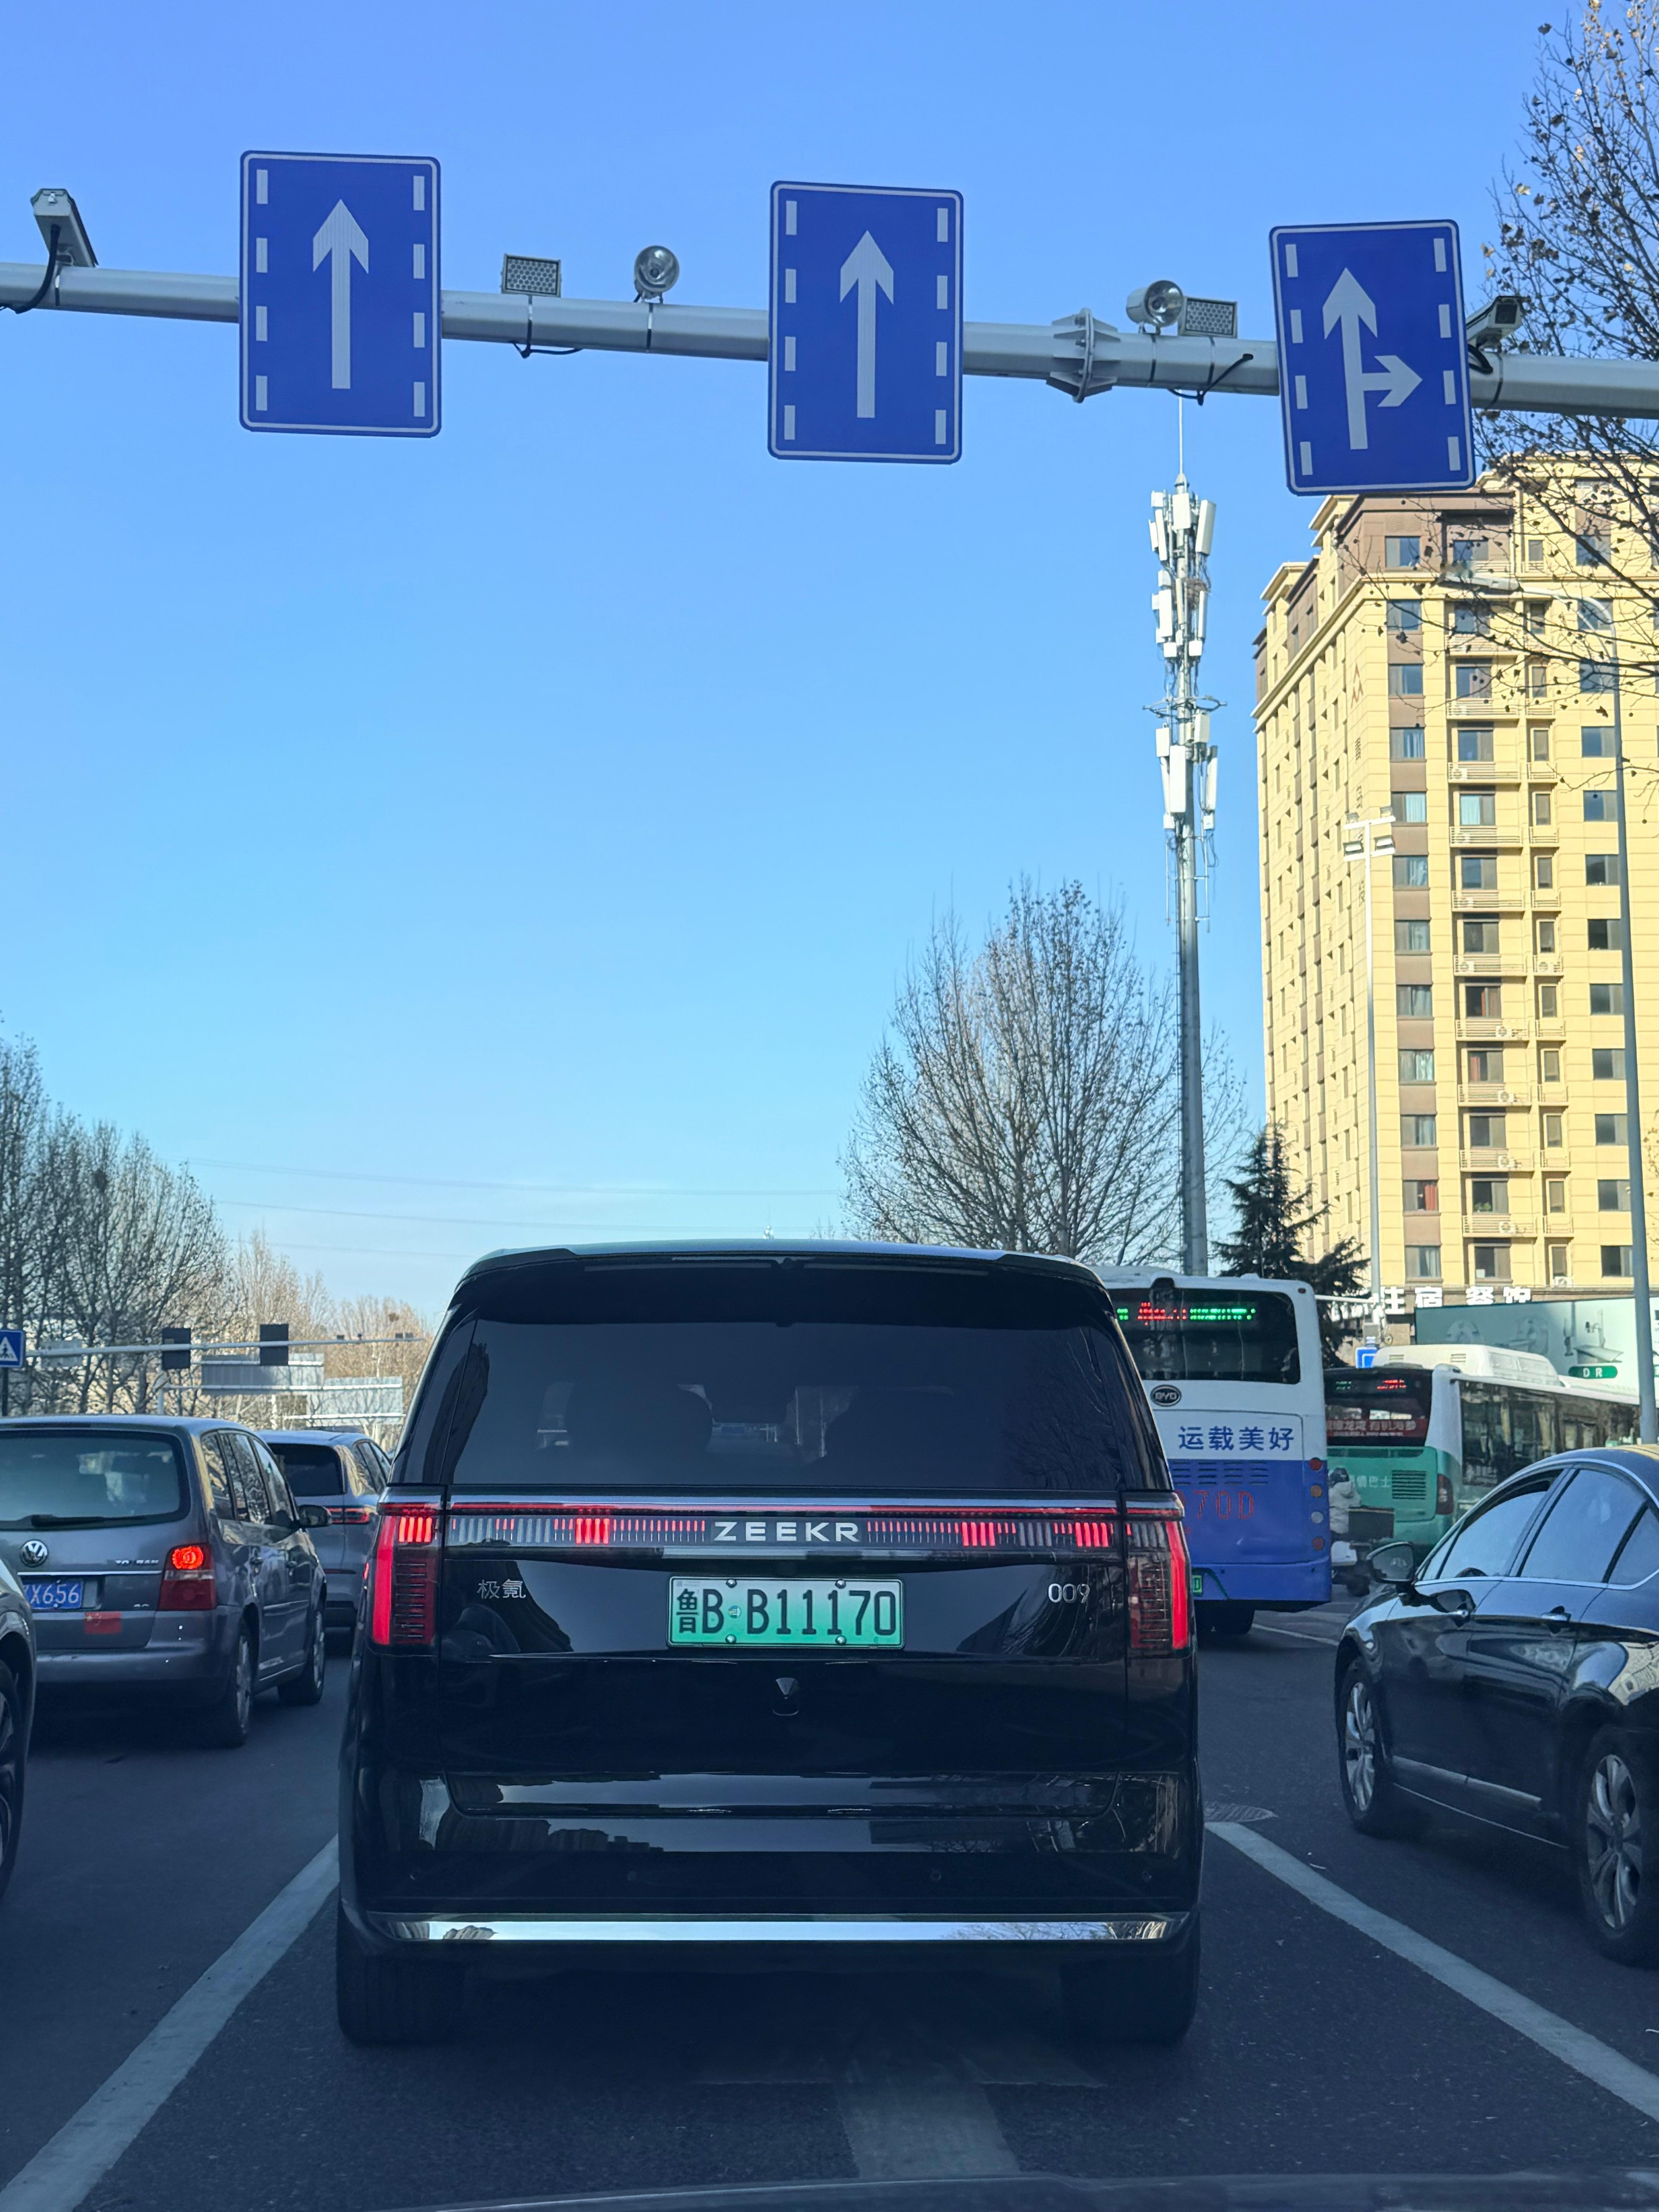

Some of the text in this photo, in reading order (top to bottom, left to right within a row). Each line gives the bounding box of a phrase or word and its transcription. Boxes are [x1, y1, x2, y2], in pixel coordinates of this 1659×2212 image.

[1178, 1426, 1294, 1451] 运载美好
[714, 1522, 860, 1542] ZEEKR
[477, 1579, 526, 1599] 极氪
[1048, 1583, 1091, 1603] 009
